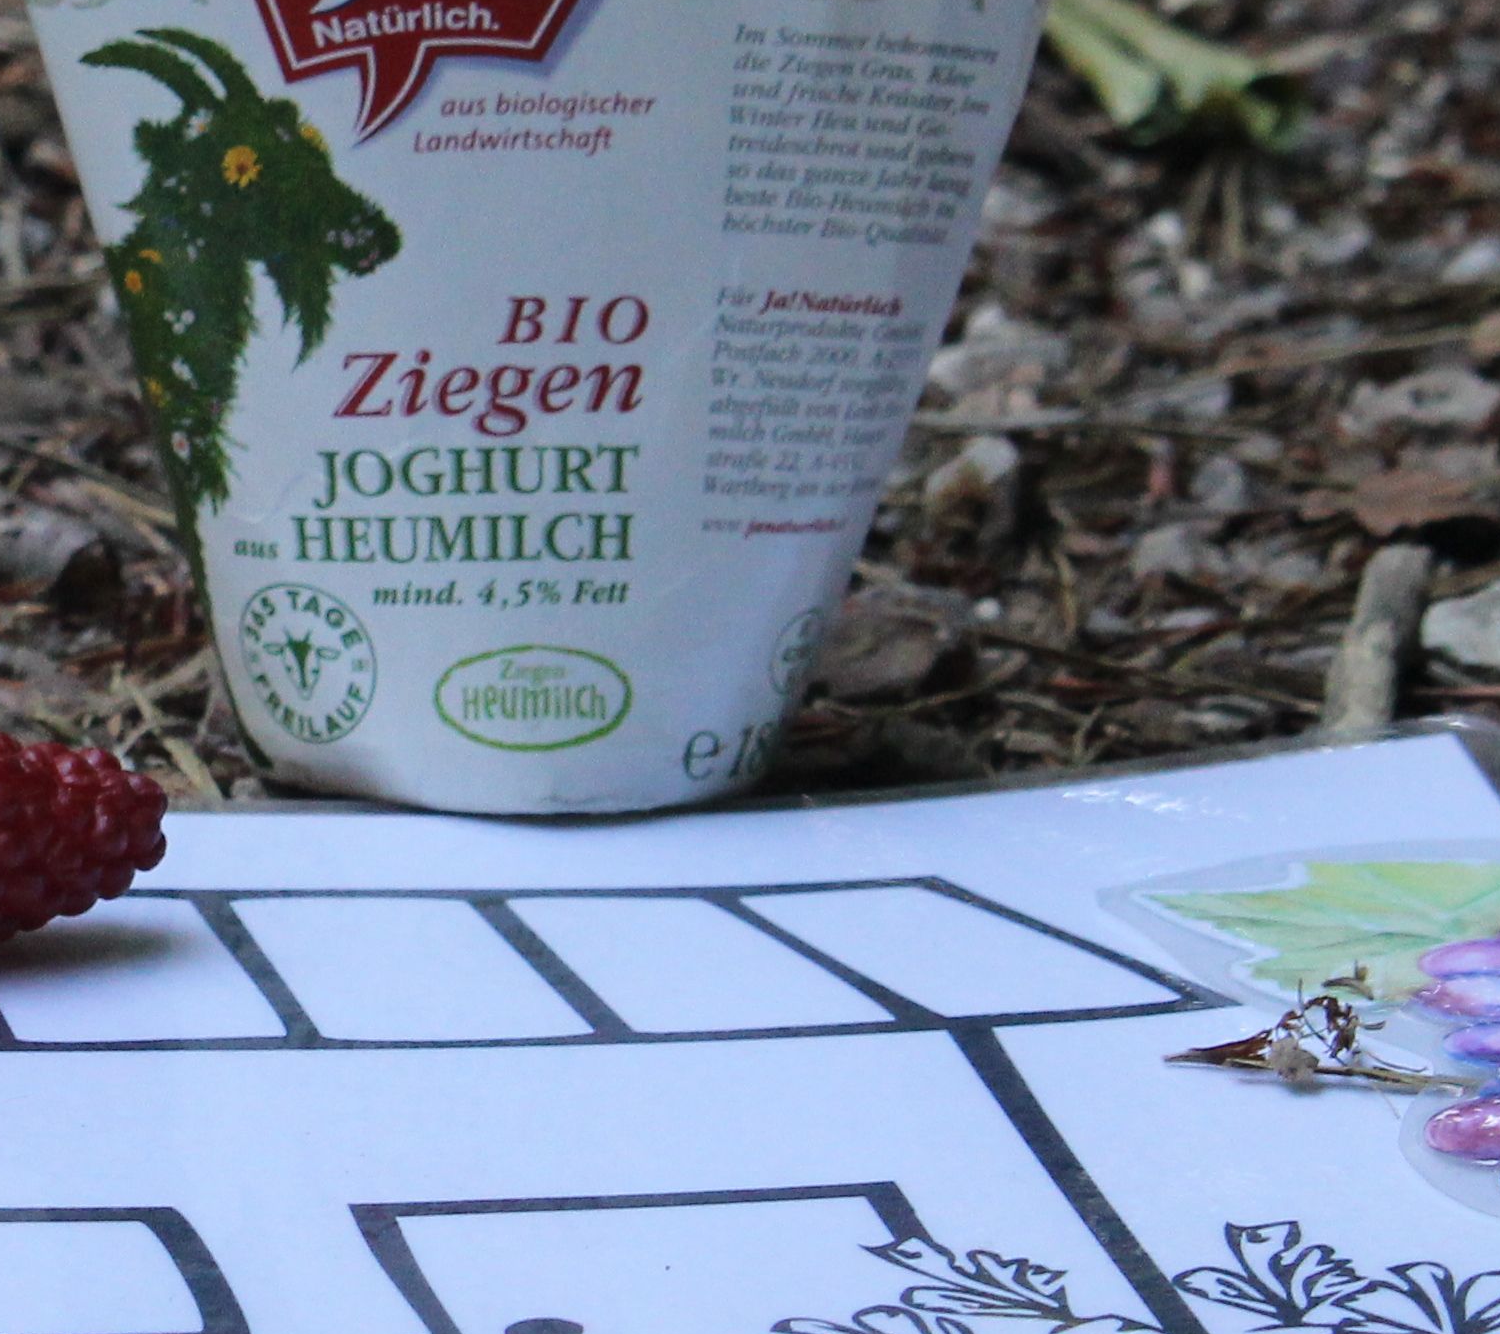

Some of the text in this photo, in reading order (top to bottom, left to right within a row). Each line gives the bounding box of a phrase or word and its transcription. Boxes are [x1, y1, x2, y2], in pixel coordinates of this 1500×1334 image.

[311, 2, 500, 48] Natürlich.
[440, 92, 656, 125] aus biologischer
[413, 126, 613, 156] Landwirtschaft
[498, 295, 650, 345] BIO
[333, 349, 644, 437] Ziegen
[313, 444, 641, 510] JOGHURT
[233, 512, 634, 563] aus HEUMILCH
[285, 589, 364, 649] TAGE
[373, 579, 630, 610] mind. 4,5% Fett
